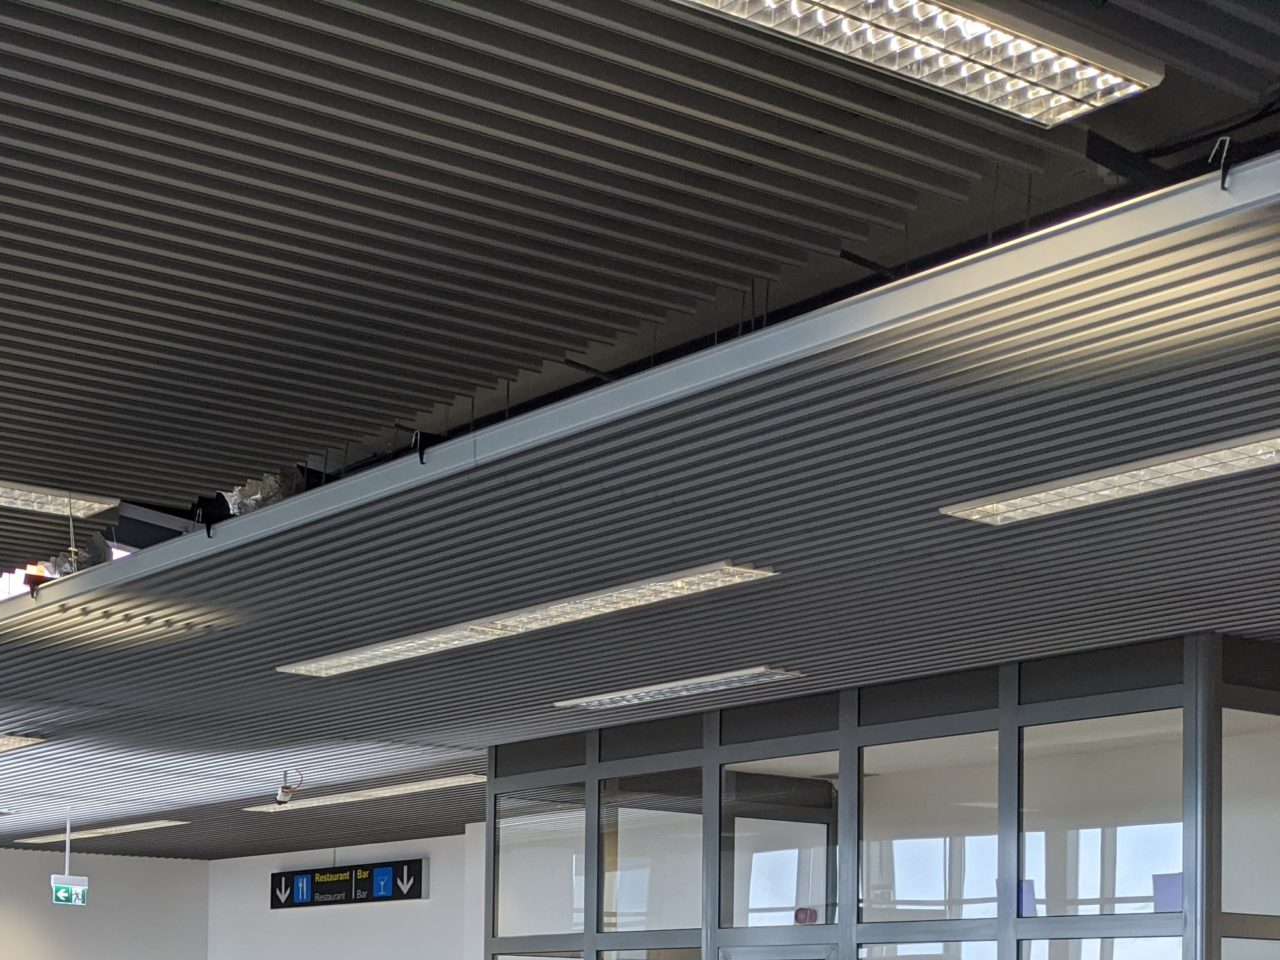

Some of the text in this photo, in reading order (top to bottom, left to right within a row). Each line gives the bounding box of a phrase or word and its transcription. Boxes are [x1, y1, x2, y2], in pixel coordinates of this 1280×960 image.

[314, 870, 350, 882] Restaurant
[356, 868, 370, 879] Bar
[314, 892, 346, 902] Restaurant
[356, 889, 368, 899] Bar
